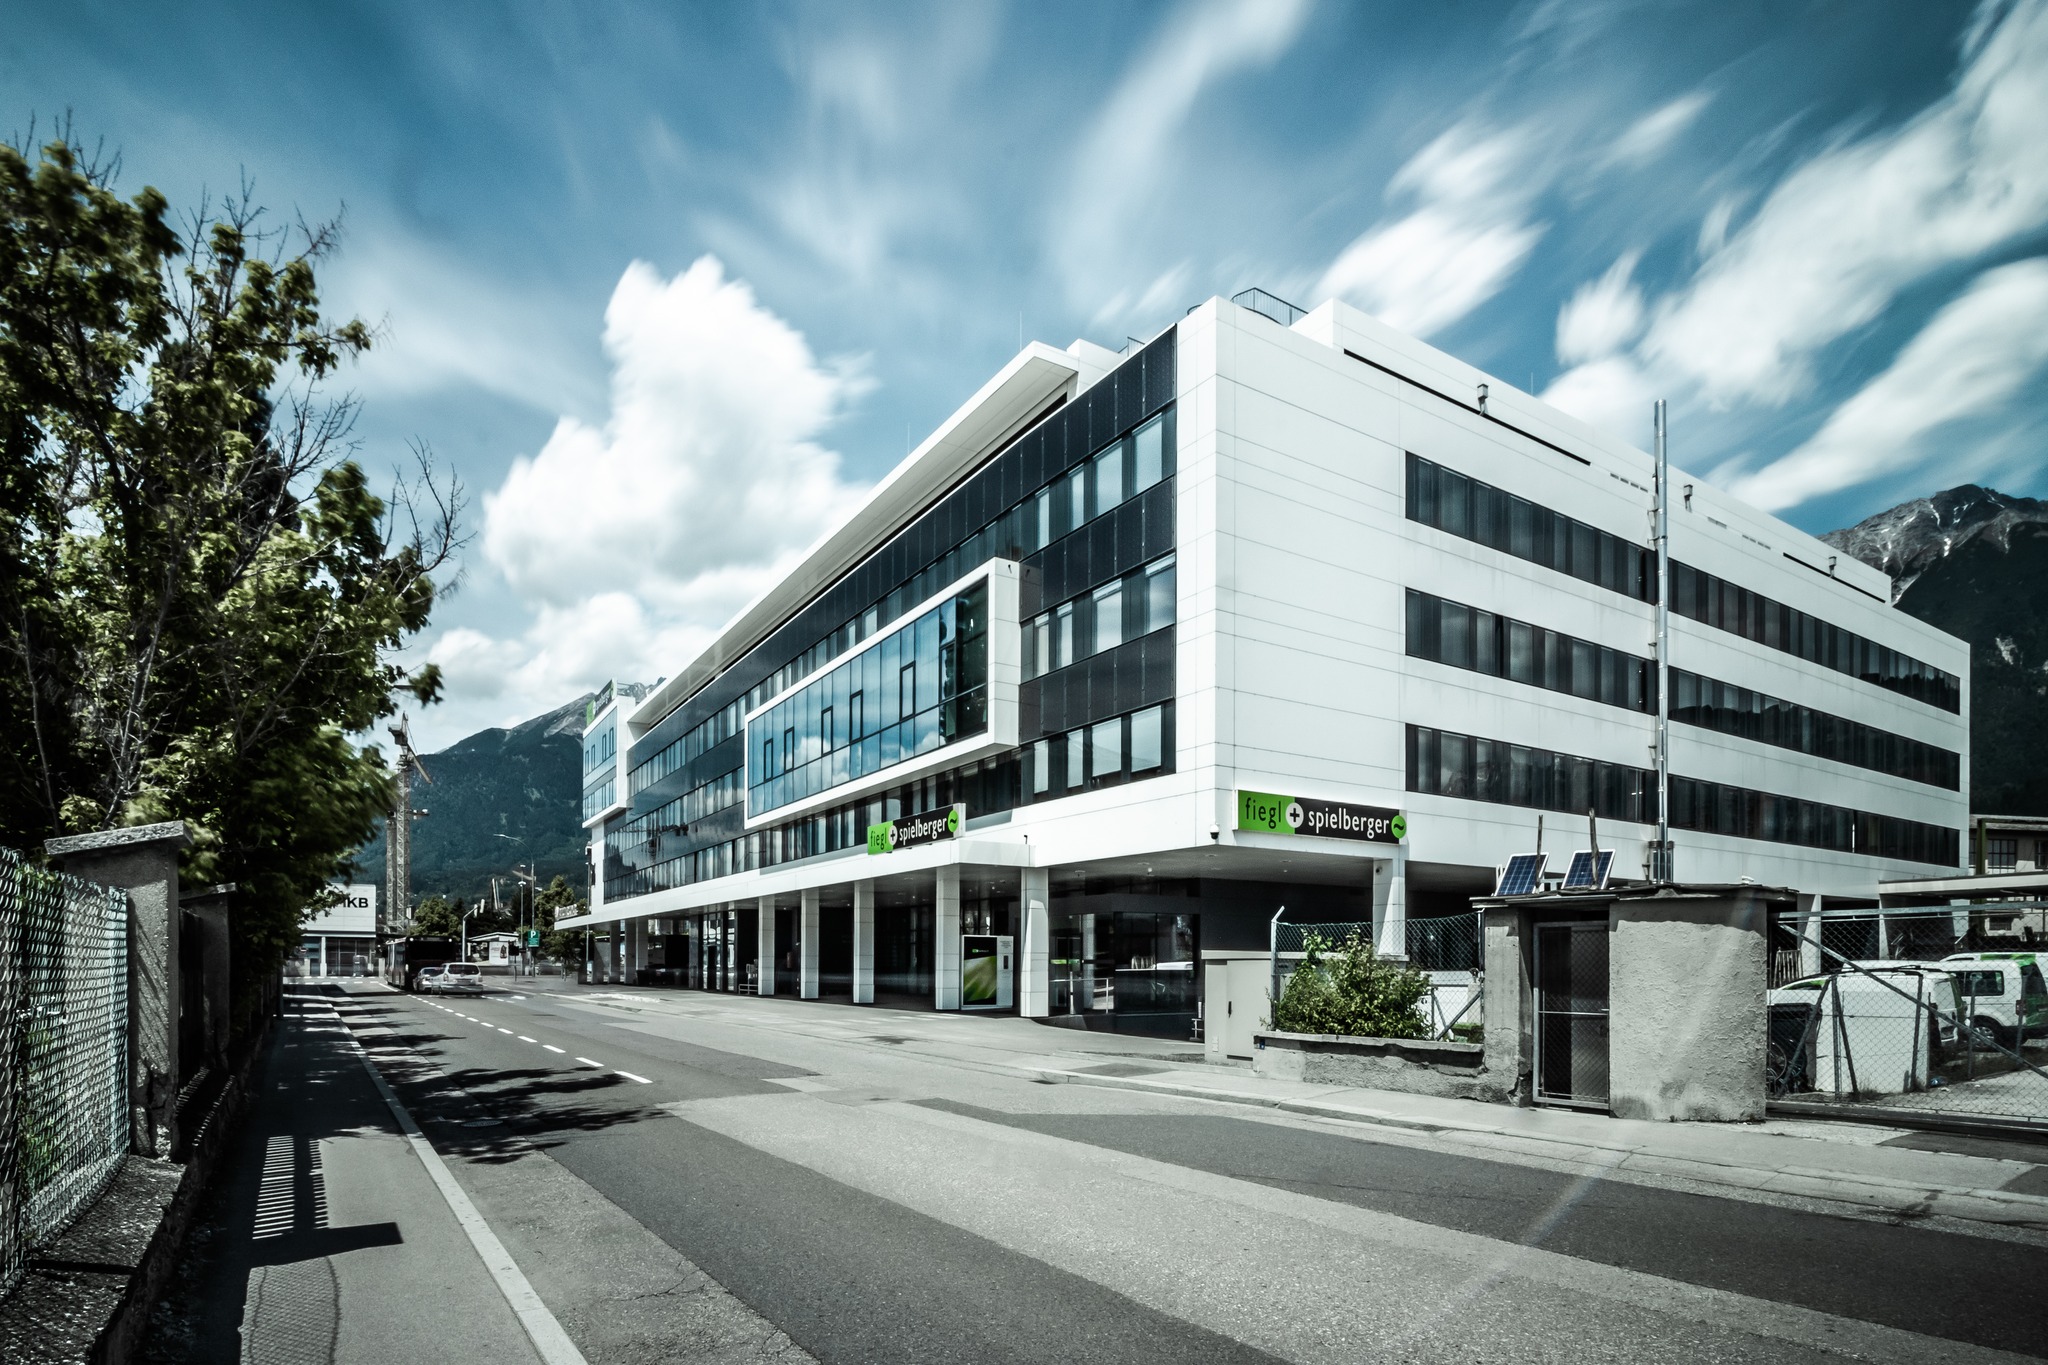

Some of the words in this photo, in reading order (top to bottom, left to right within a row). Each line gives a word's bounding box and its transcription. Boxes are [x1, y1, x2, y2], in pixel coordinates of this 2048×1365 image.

[870, 828, 887, 850] fiegl
[899, 818, 947, 845] spielberger
[1245, 797, 1281, 829] fiegl
[1308, 807, 1390, 839] spielberger
[530, 930, 536, 938] P
